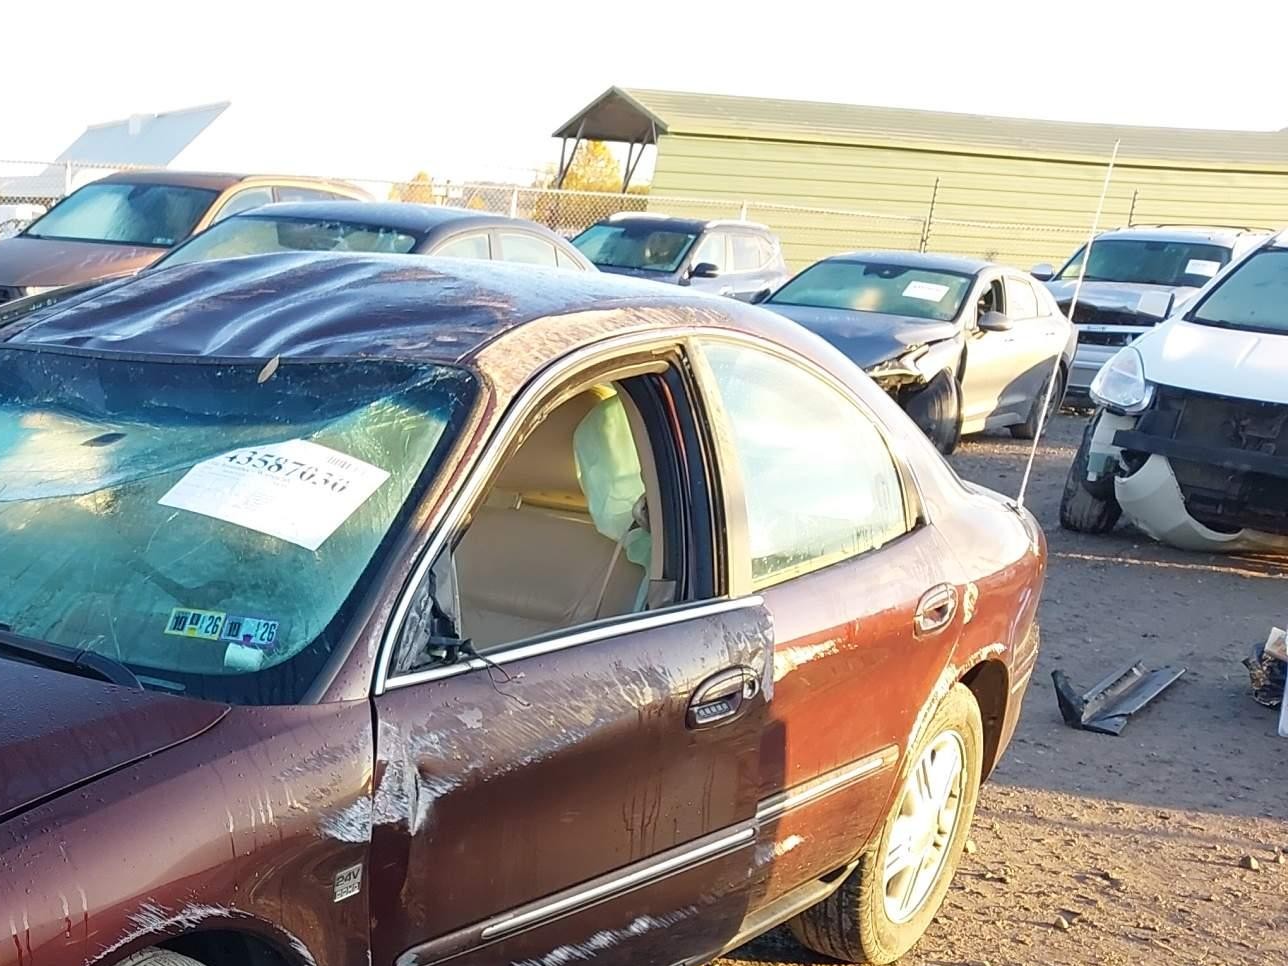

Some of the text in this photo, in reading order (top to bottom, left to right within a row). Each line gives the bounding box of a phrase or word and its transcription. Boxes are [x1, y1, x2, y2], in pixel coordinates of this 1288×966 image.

[204, 615, 222, 634] 26
[259, 622, 277, 641] 26
[336, 868, 360, 887] 24V
